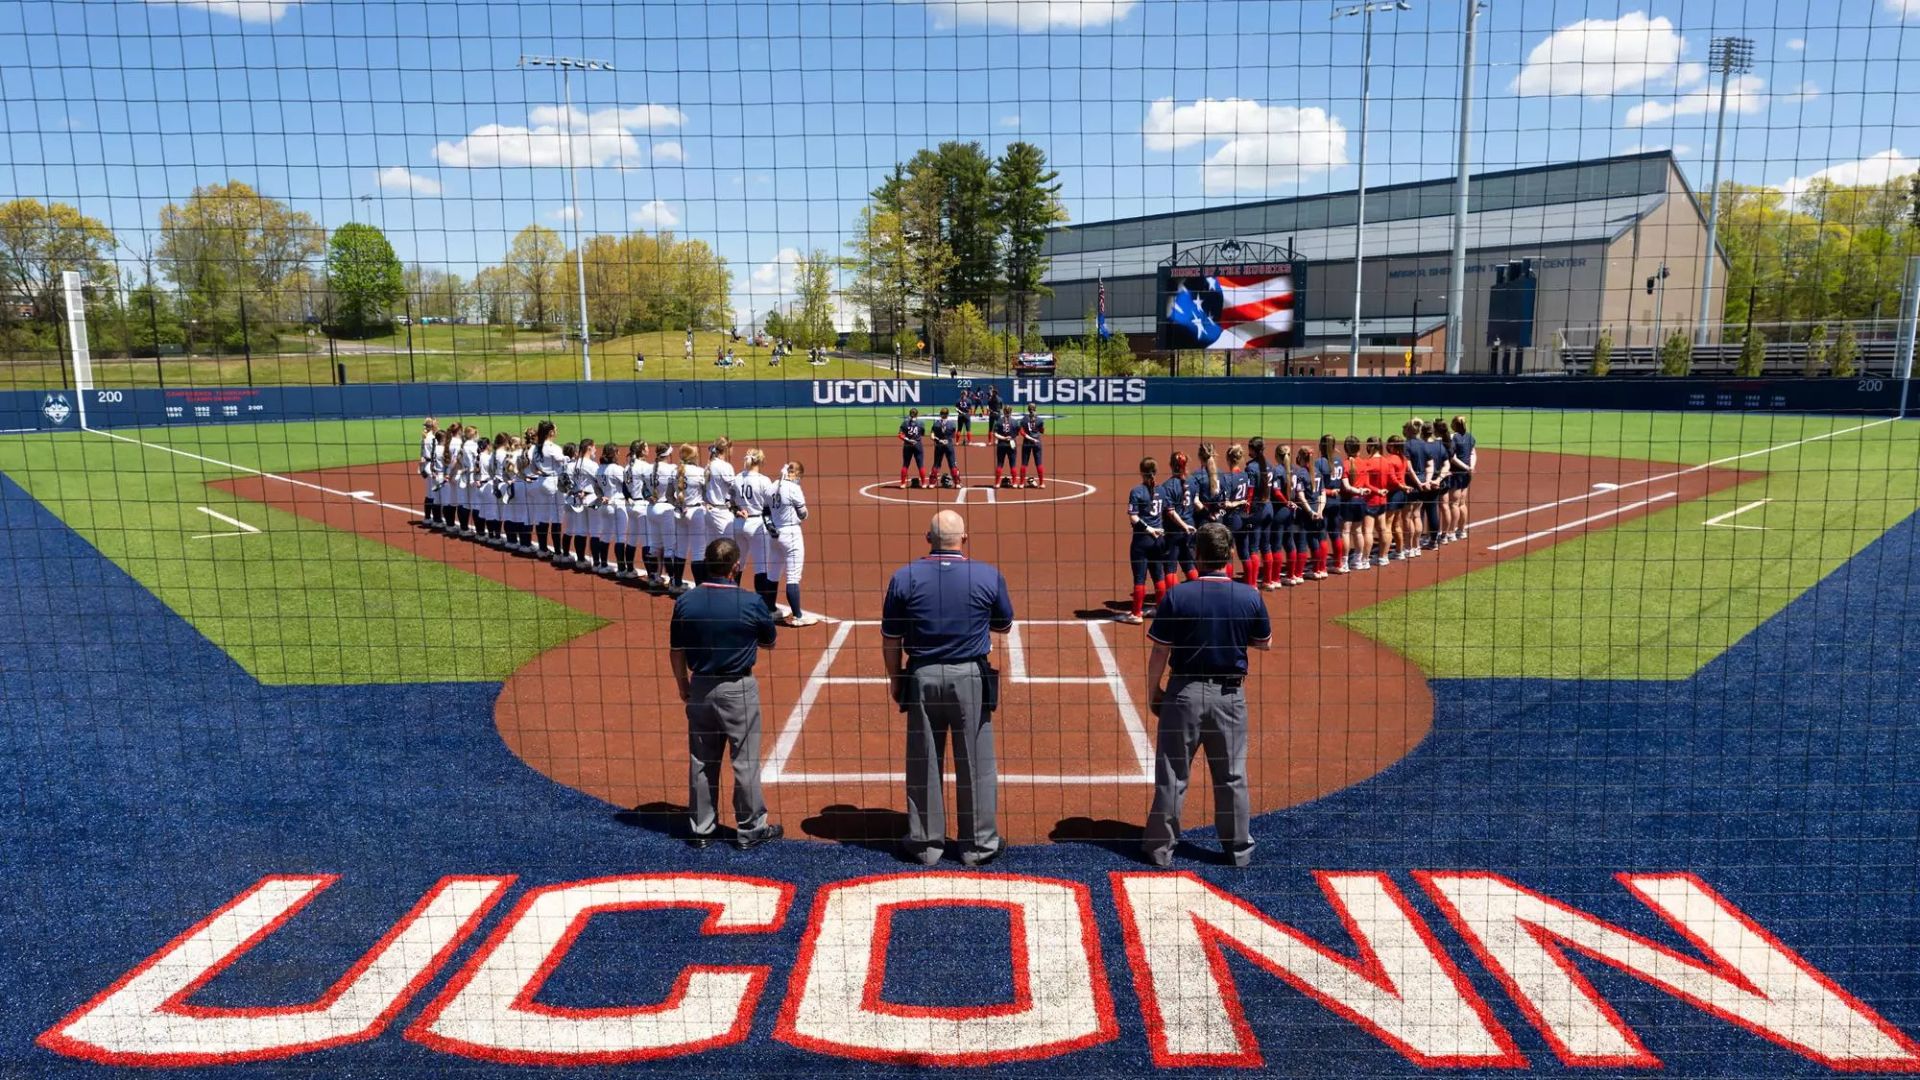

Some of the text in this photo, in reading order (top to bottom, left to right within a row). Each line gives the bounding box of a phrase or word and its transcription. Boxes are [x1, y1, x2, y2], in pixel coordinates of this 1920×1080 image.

[1542, 258, 1586, 268] CENTER
[812, 379, 921, 404] UCONN
[956, 379, 972, 388] 220
[1013, 377, 1146, 403] HUSKIES
[1857, 379, 1883, 392] 200
[97, 390, 123, 403] 200
[907, 426, 918, 436] 24
[741, 484, 753, 500] 10
[1235, 483, 1247, 500] 21
[1149, 498, 1163, 516] 31
[35, 870, 1920, 1069] UCONN
